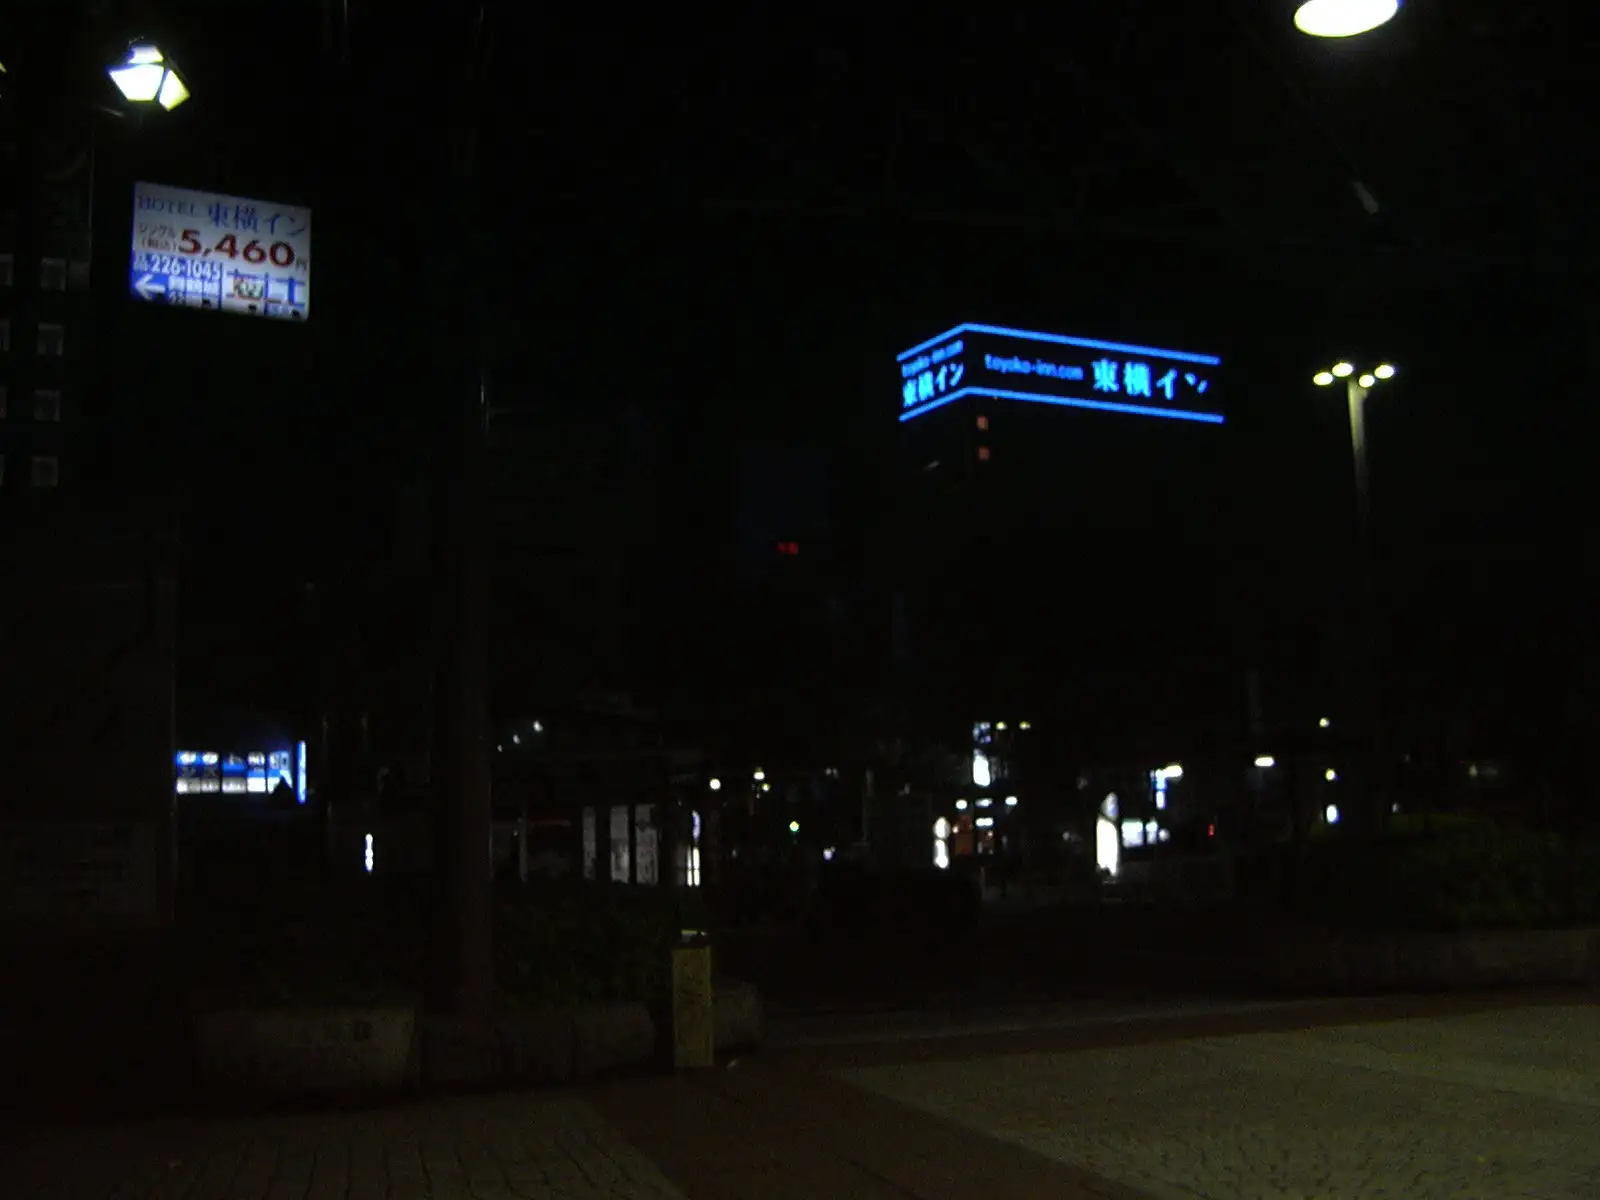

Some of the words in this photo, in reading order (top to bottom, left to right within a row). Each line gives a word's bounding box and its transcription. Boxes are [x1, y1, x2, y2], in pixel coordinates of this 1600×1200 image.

[138, 196, 196, 216] HOTEL
[207, 202, 307, 236] 東横イン
[1092, 358, 1208, 400] 東横イン
